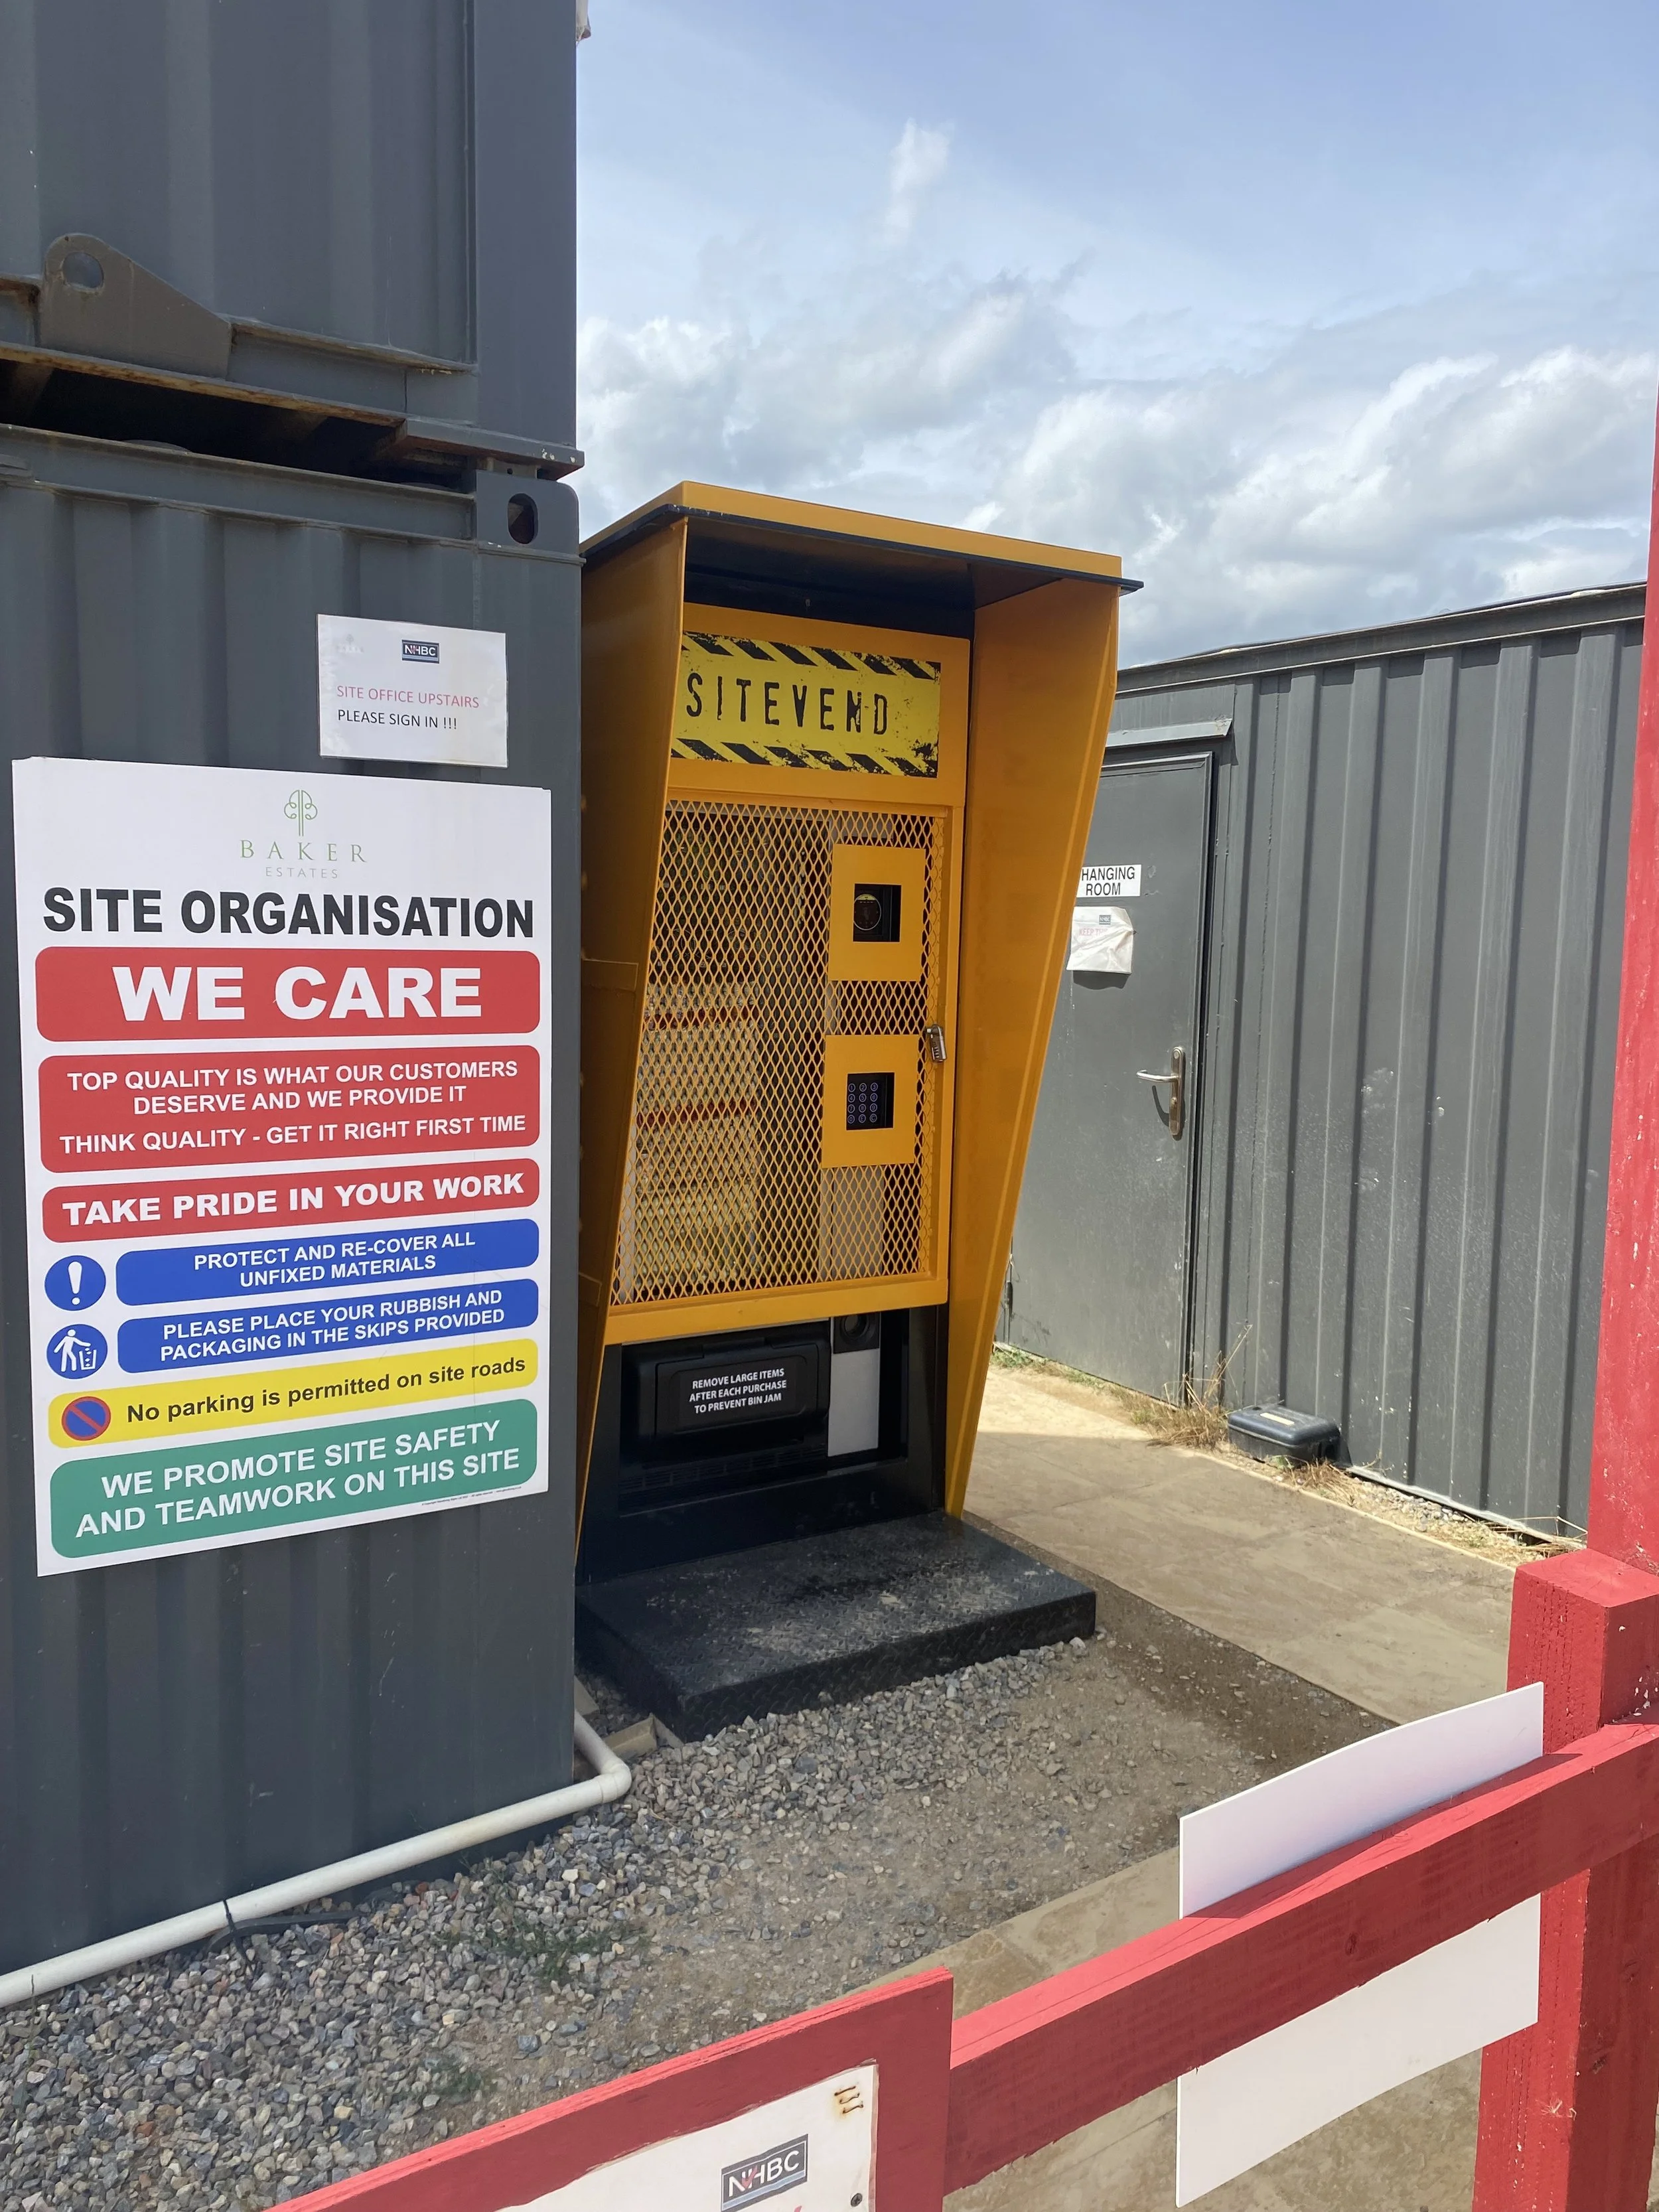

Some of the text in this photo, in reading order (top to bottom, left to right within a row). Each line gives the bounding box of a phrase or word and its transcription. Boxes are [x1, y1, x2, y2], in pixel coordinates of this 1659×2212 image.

[405, 644, 436, 656] NHBC
[337, 686, 479, 708] SITE OFFICE UPSTAIRS
[686, 672, 888, 735] SITEVEND
[338, 709, 457, 729] PLEASE SIGN IN !!!
[240, 839, 367, 863] BAKER
[265, 866, 339, 879] ESTATES
[1082, 867, 1135, 881] HANGING
[1086, 883, 1121, 895] ROOM
[43, 887, 533, 938] SITE ORGANISATION
[112, 966, 482, 1021] WE CARE
[67, 1061, 518, 1091] TOP QUALITY IS WHAT OUR CUSTOMERS
[133, 1086, 467, 1115] DESERVE AND WE PROVIDE IT
[60, 1133, 135, 1154] THINK
[142, 1128, 246, 1150] QUALITY
[267, 1126, 313, 1145] GET
[319, 1124, 338, 1142] IT
[344, 1120, 409, 1141] RIGHT
[416, 1118, 474, 1136] FIRST
[480, 1115, 526, 1133] TIME
[62, 1173, 524, 1226] TAKE PRIDE IN YOUR WORK
[194, 1232, 475, 1270] PROTECT AND RE-COVER ALL
[240, 1255, 436, 1288] UNFIXED MATERIALS
[164, 1290, 502, 1343] PLEASE PLACE YOUR RUBBISH AND
[160, 1309, 505, 1362] PACKAGING IN THE SKIPS PROVIDED
[127, 1355, 526, 1423] No parking is permitted on site roads
[689, 1380, 786, 1402] AFTER EACH PURCHASE
[693, 1368, 784, 1389] REMOVE LARGE ITEMS
[695, 1393, 782, 1414] TO PREVENT BIN JAM
[102, 1420, 500, 1499] WE PROMOTE SITE SAFETY
[75, 1448, 520, 1538] AND TEAMWORK ON THIS SITE
[727, 2150, 799, 2197] NHBC
